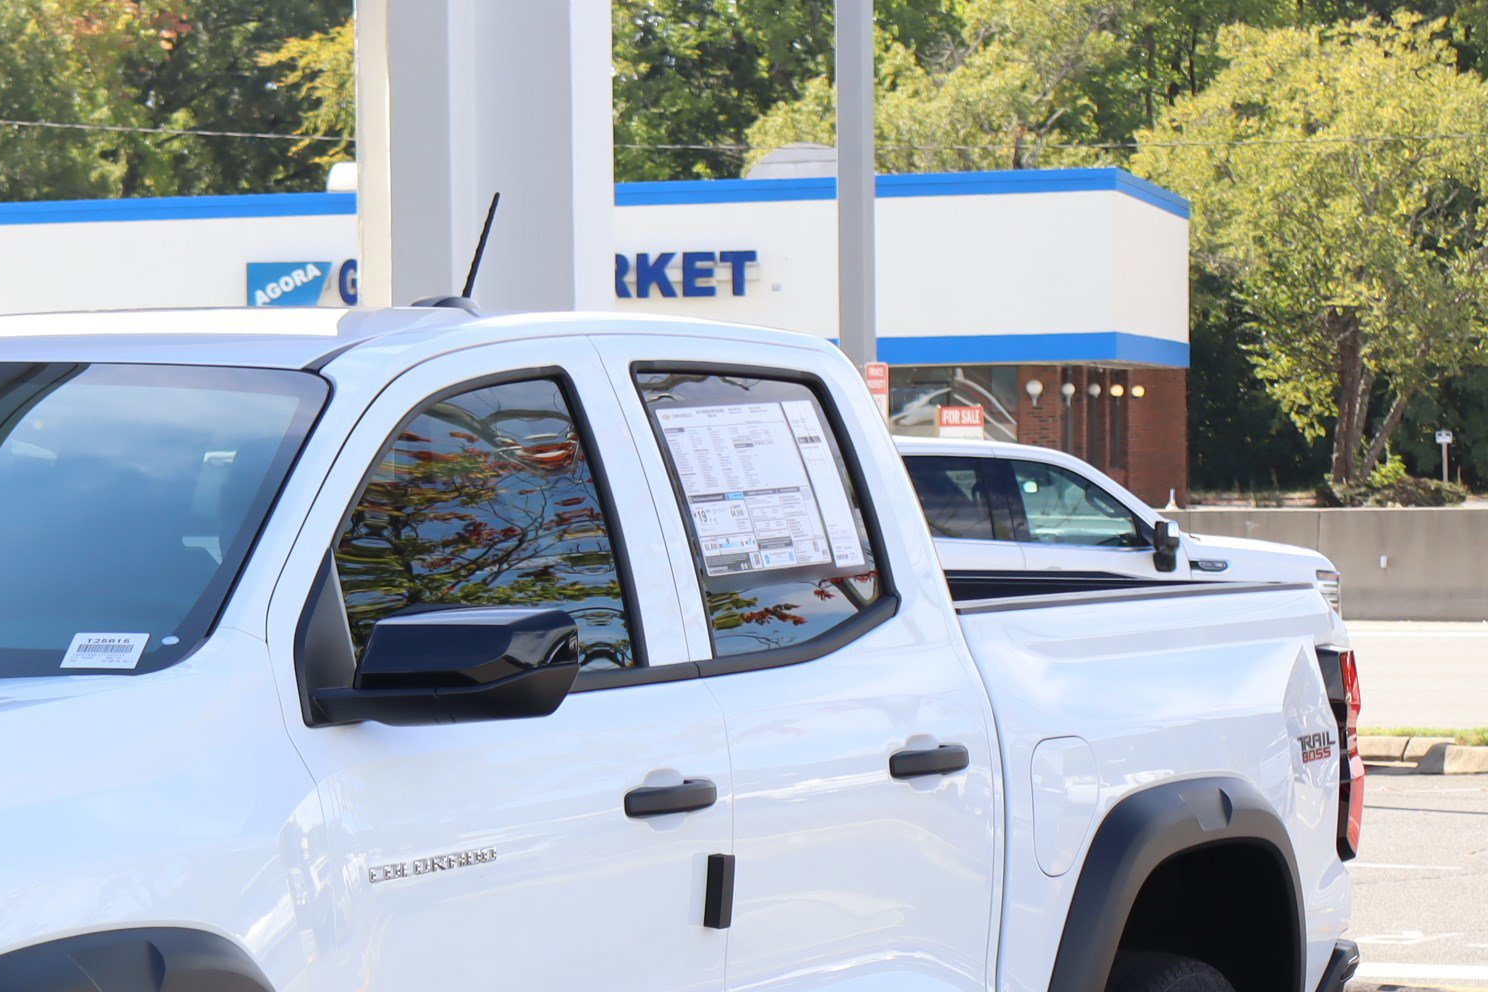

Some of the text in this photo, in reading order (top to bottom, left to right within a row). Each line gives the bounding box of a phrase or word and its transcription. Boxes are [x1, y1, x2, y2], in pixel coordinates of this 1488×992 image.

[254, 263, 322, 306] AGORA
[943, 409, 981, 425] FOR SALE
[1297, 730, 1336, 751] TRAIL
[1302, 746, 1331, 764] BOSS
[368, 846, 497, 883] COLORADO
